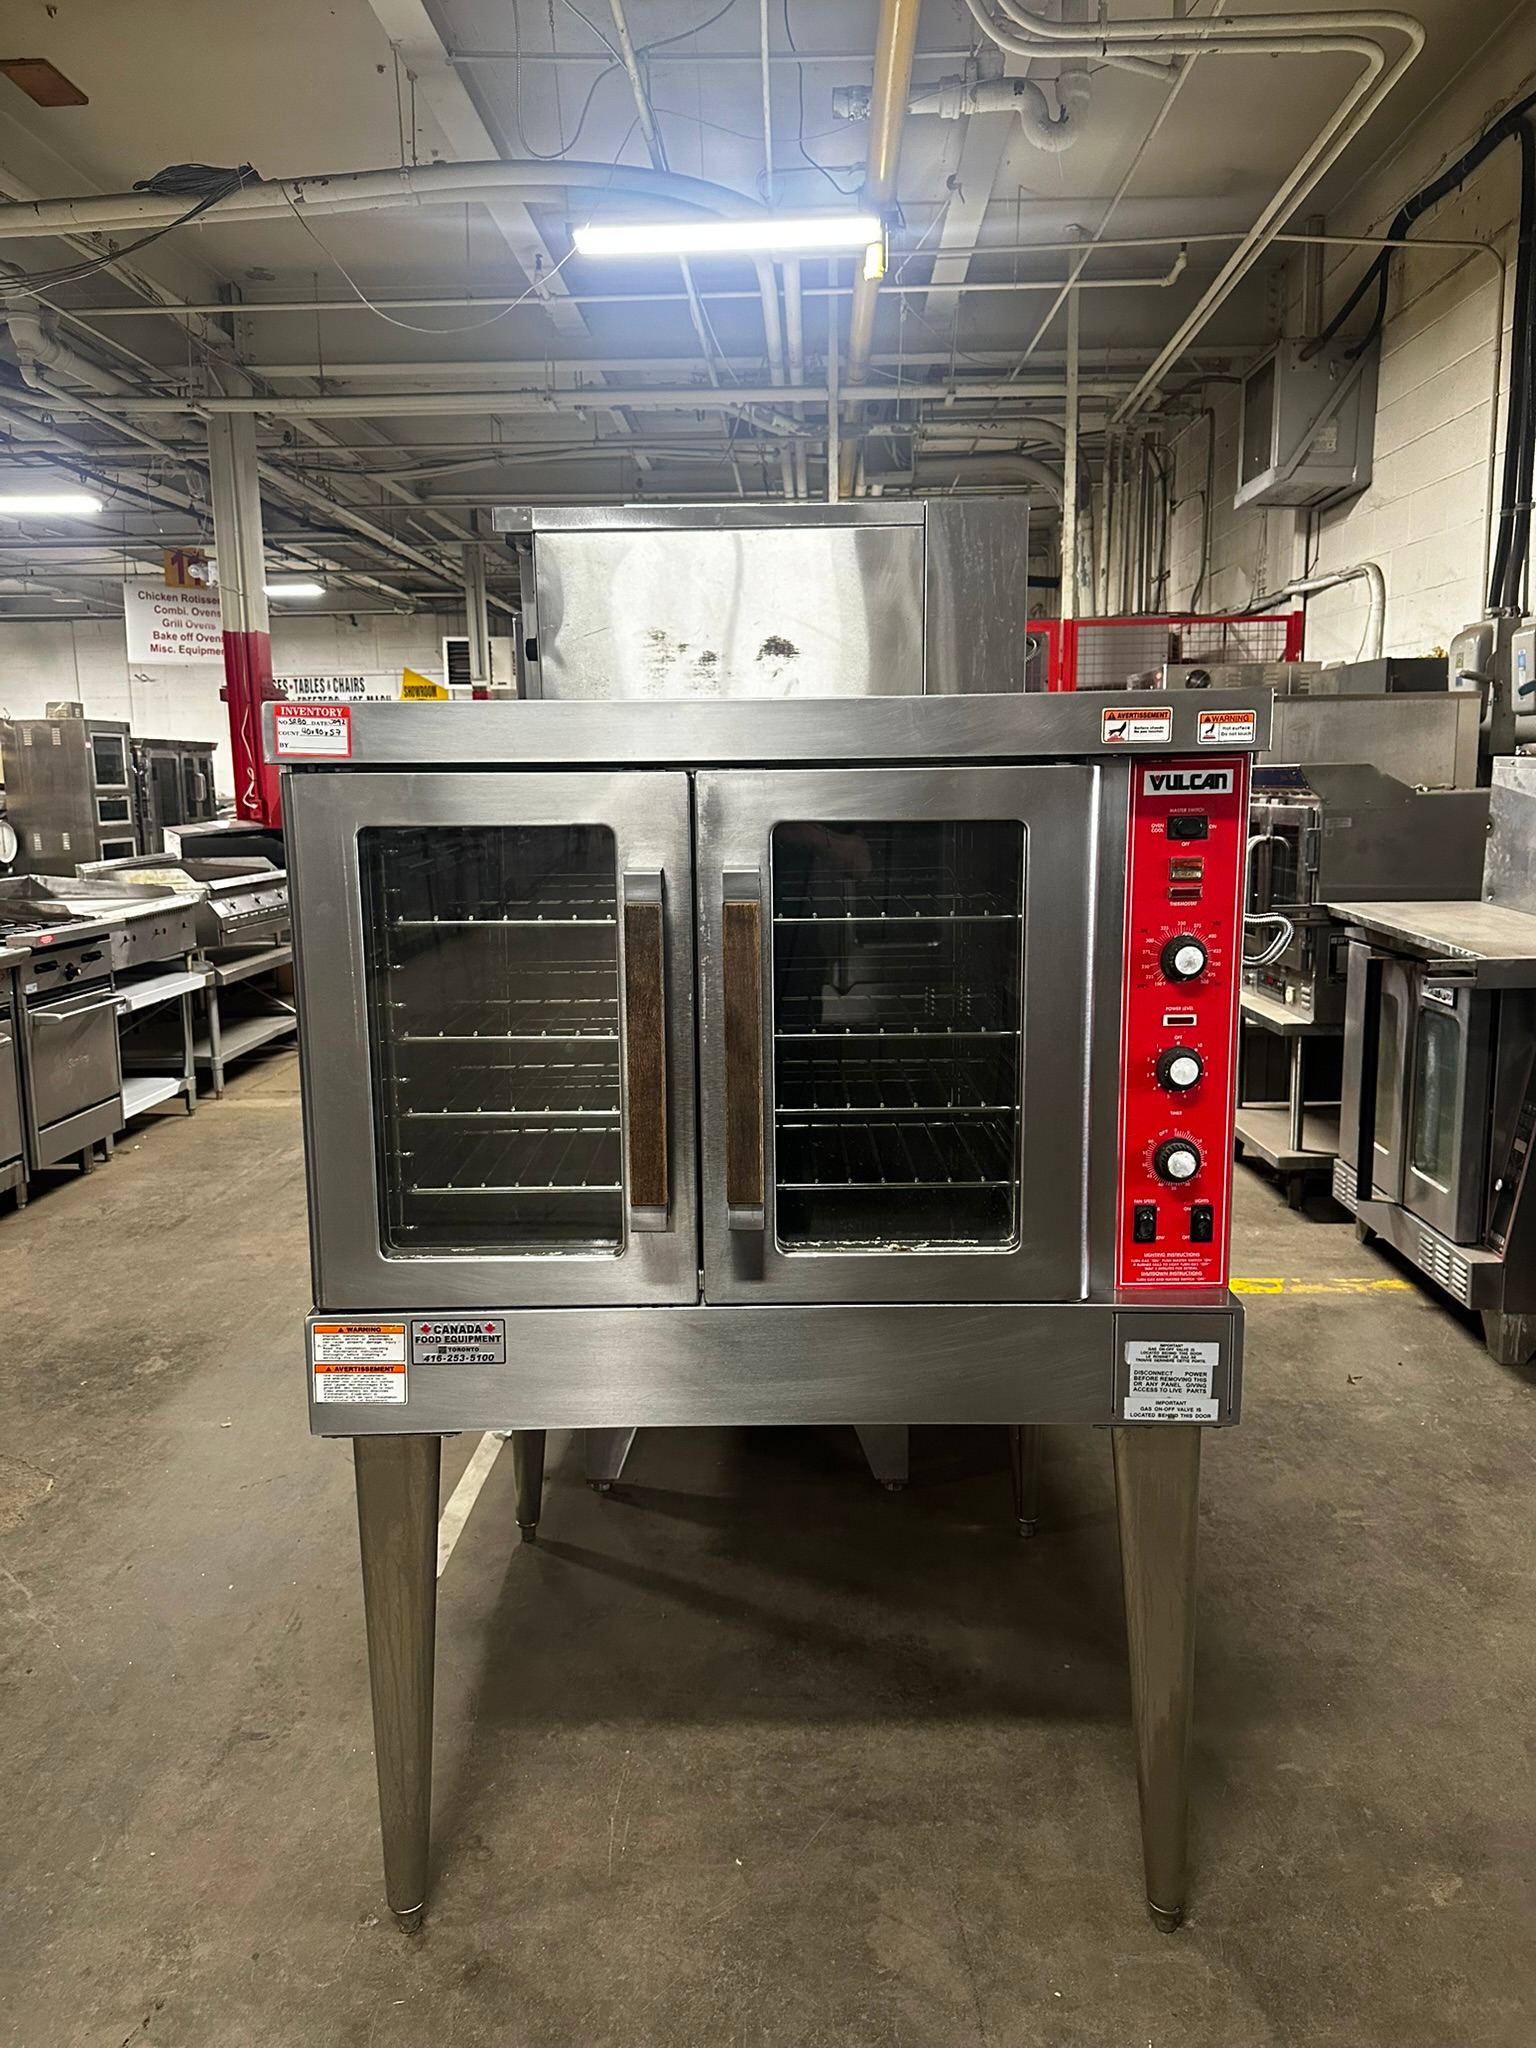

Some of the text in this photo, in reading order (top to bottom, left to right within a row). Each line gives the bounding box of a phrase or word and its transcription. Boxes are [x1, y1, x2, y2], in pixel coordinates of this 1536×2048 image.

[138, 591, 178, 602] Chicken
[154, 605, 222, 618] Combi. Ovens
[162, 618, 216, 631] Grill Ovens
[153, 631, 177, 641] Bake
[180, 632, 194, 642] off
[150, 644, 176, 654] Misc.
[293, 678, 325, 694] TABLES
[333, 677, 366, 693] CHAIRS
[404, 686, 437, 698] SHOWROOM
[280, 706, 343, 717] INVENTORY
[1117, 711, 1169, 720] AVERTISSEMENT
[1211, 714, 1249, 722] WARNING
[1150, 773, 1228, 791] VULCAN
[433, 1325, 483, 1334] CANADA
[444, 1335, 502, 1343] EQUIPMENT
[423, 1354, 495, 1362] 416-253-5100
